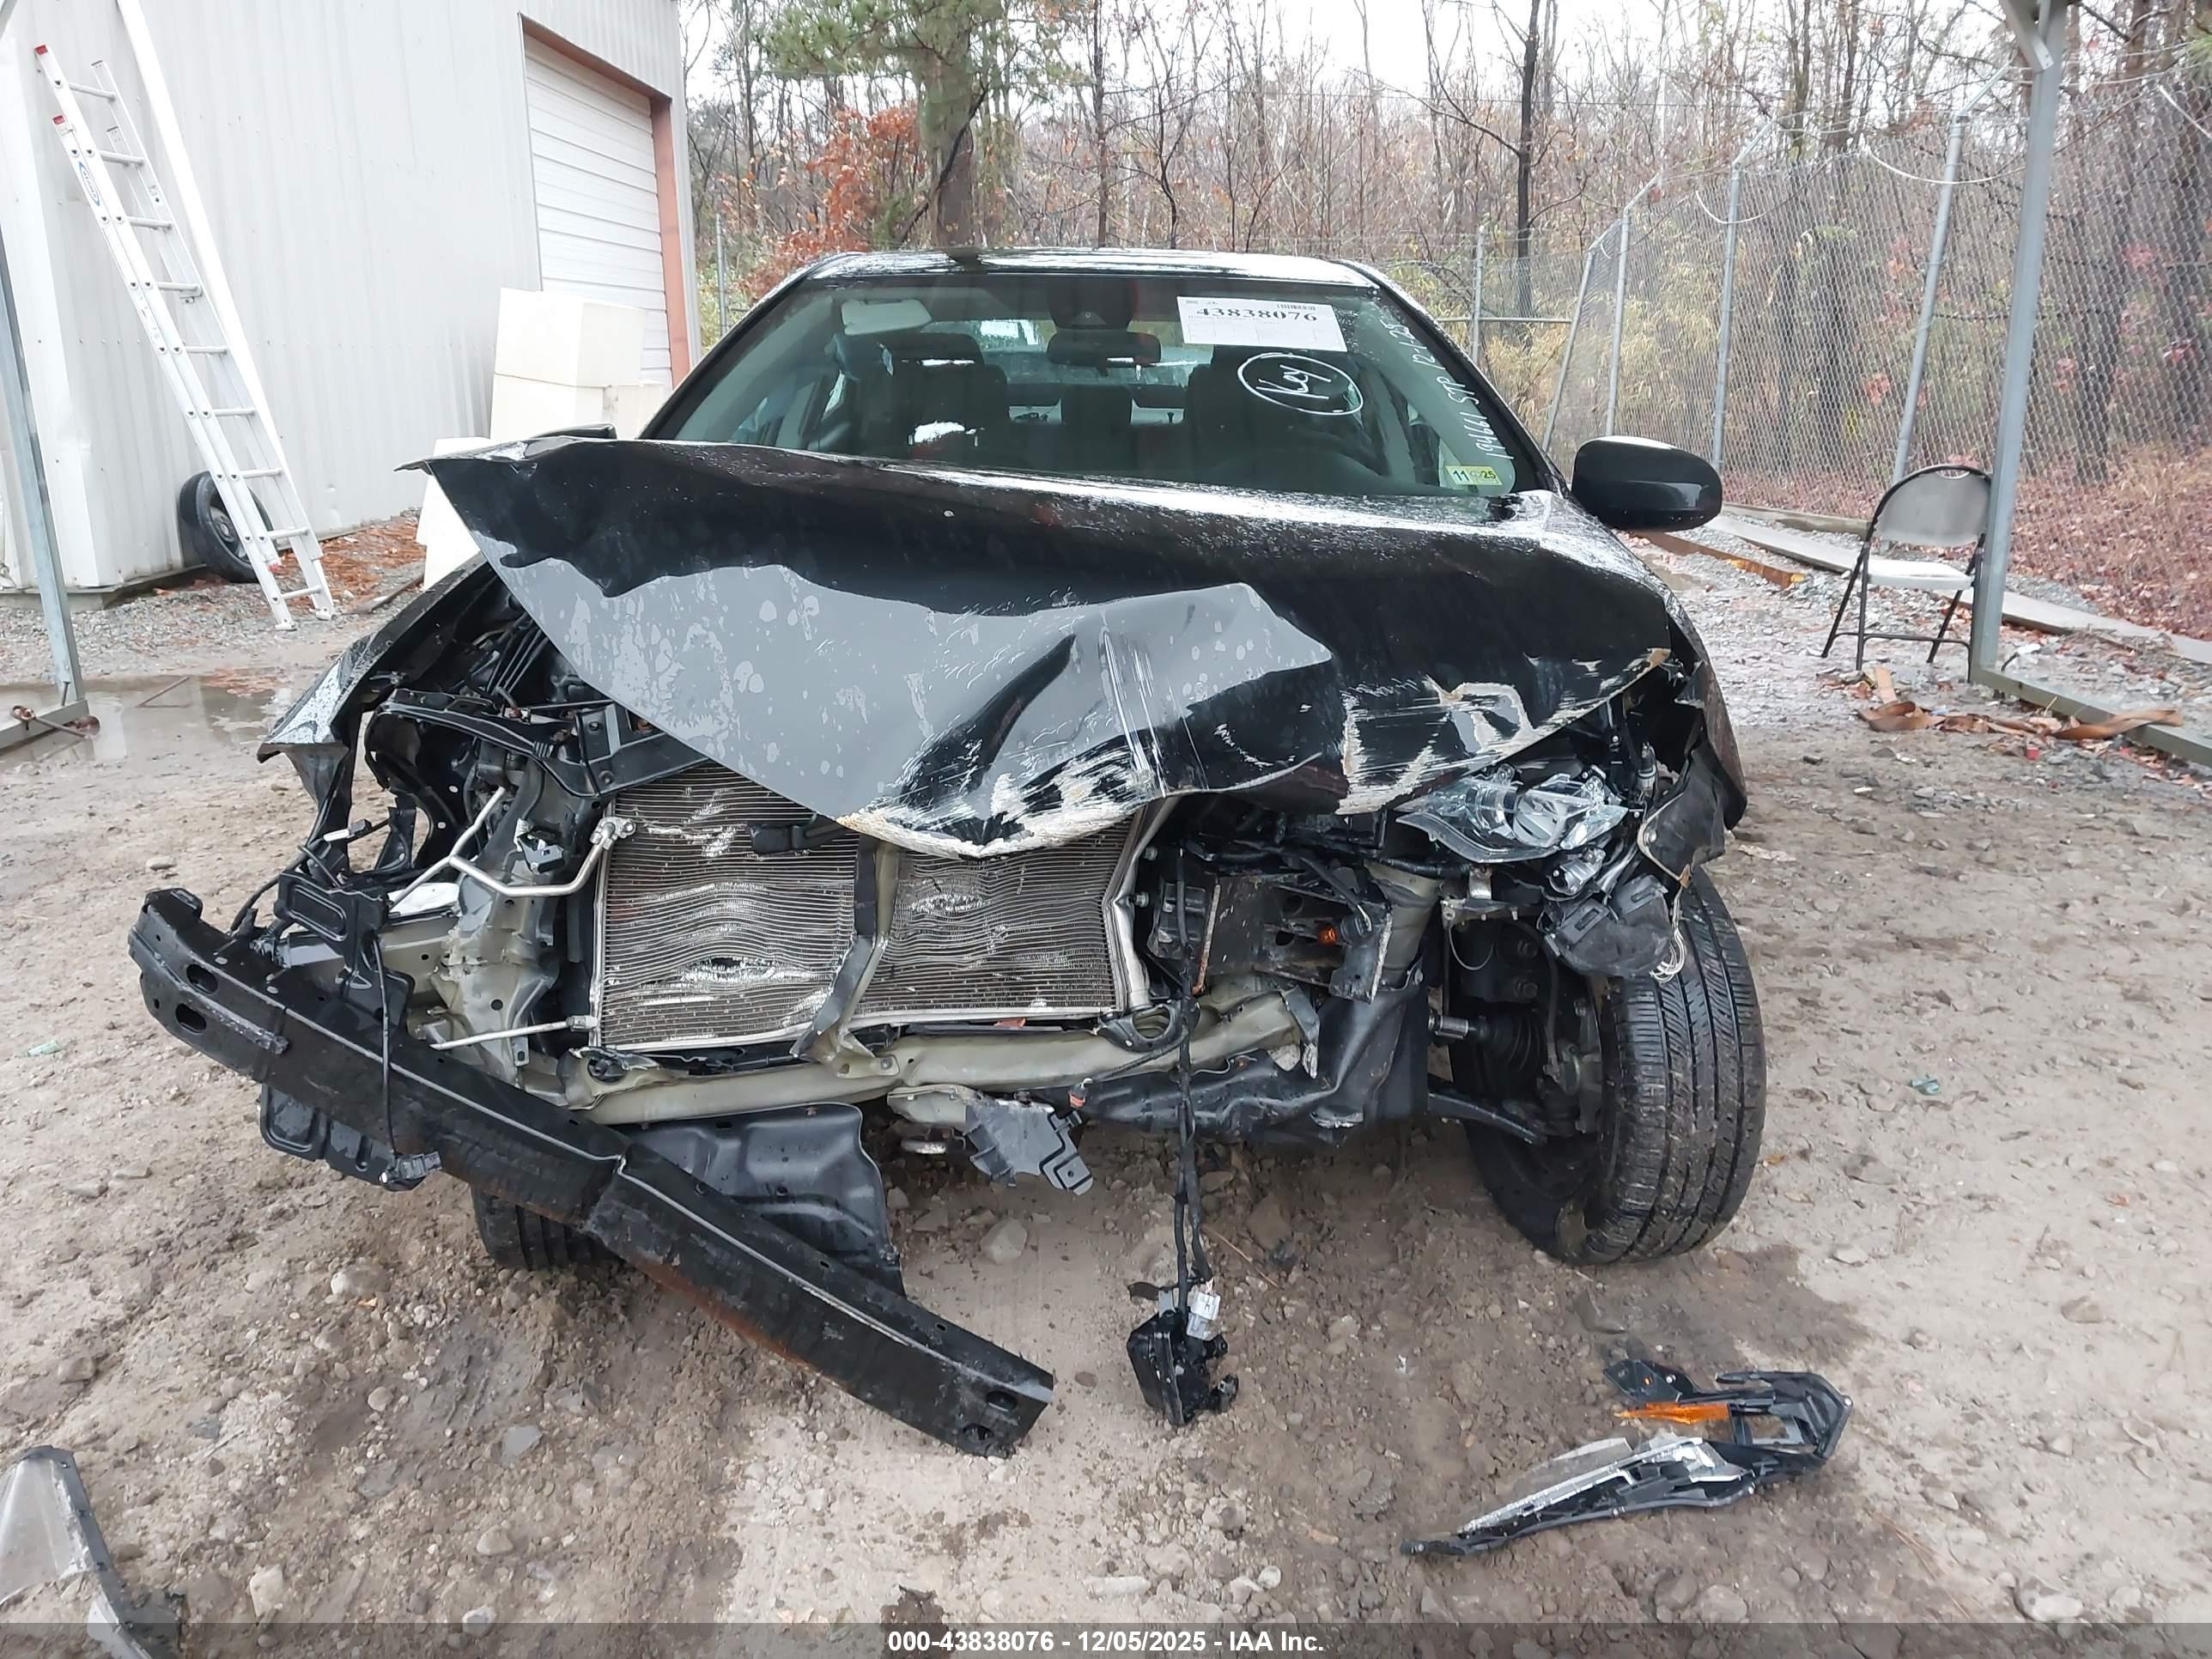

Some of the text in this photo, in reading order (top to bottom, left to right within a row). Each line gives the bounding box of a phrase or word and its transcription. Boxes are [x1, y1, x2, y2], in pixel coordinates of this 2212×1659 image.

[1196, 307, 1318, 322] 43838076
[1452, 470, 1497, 482] 11 25
